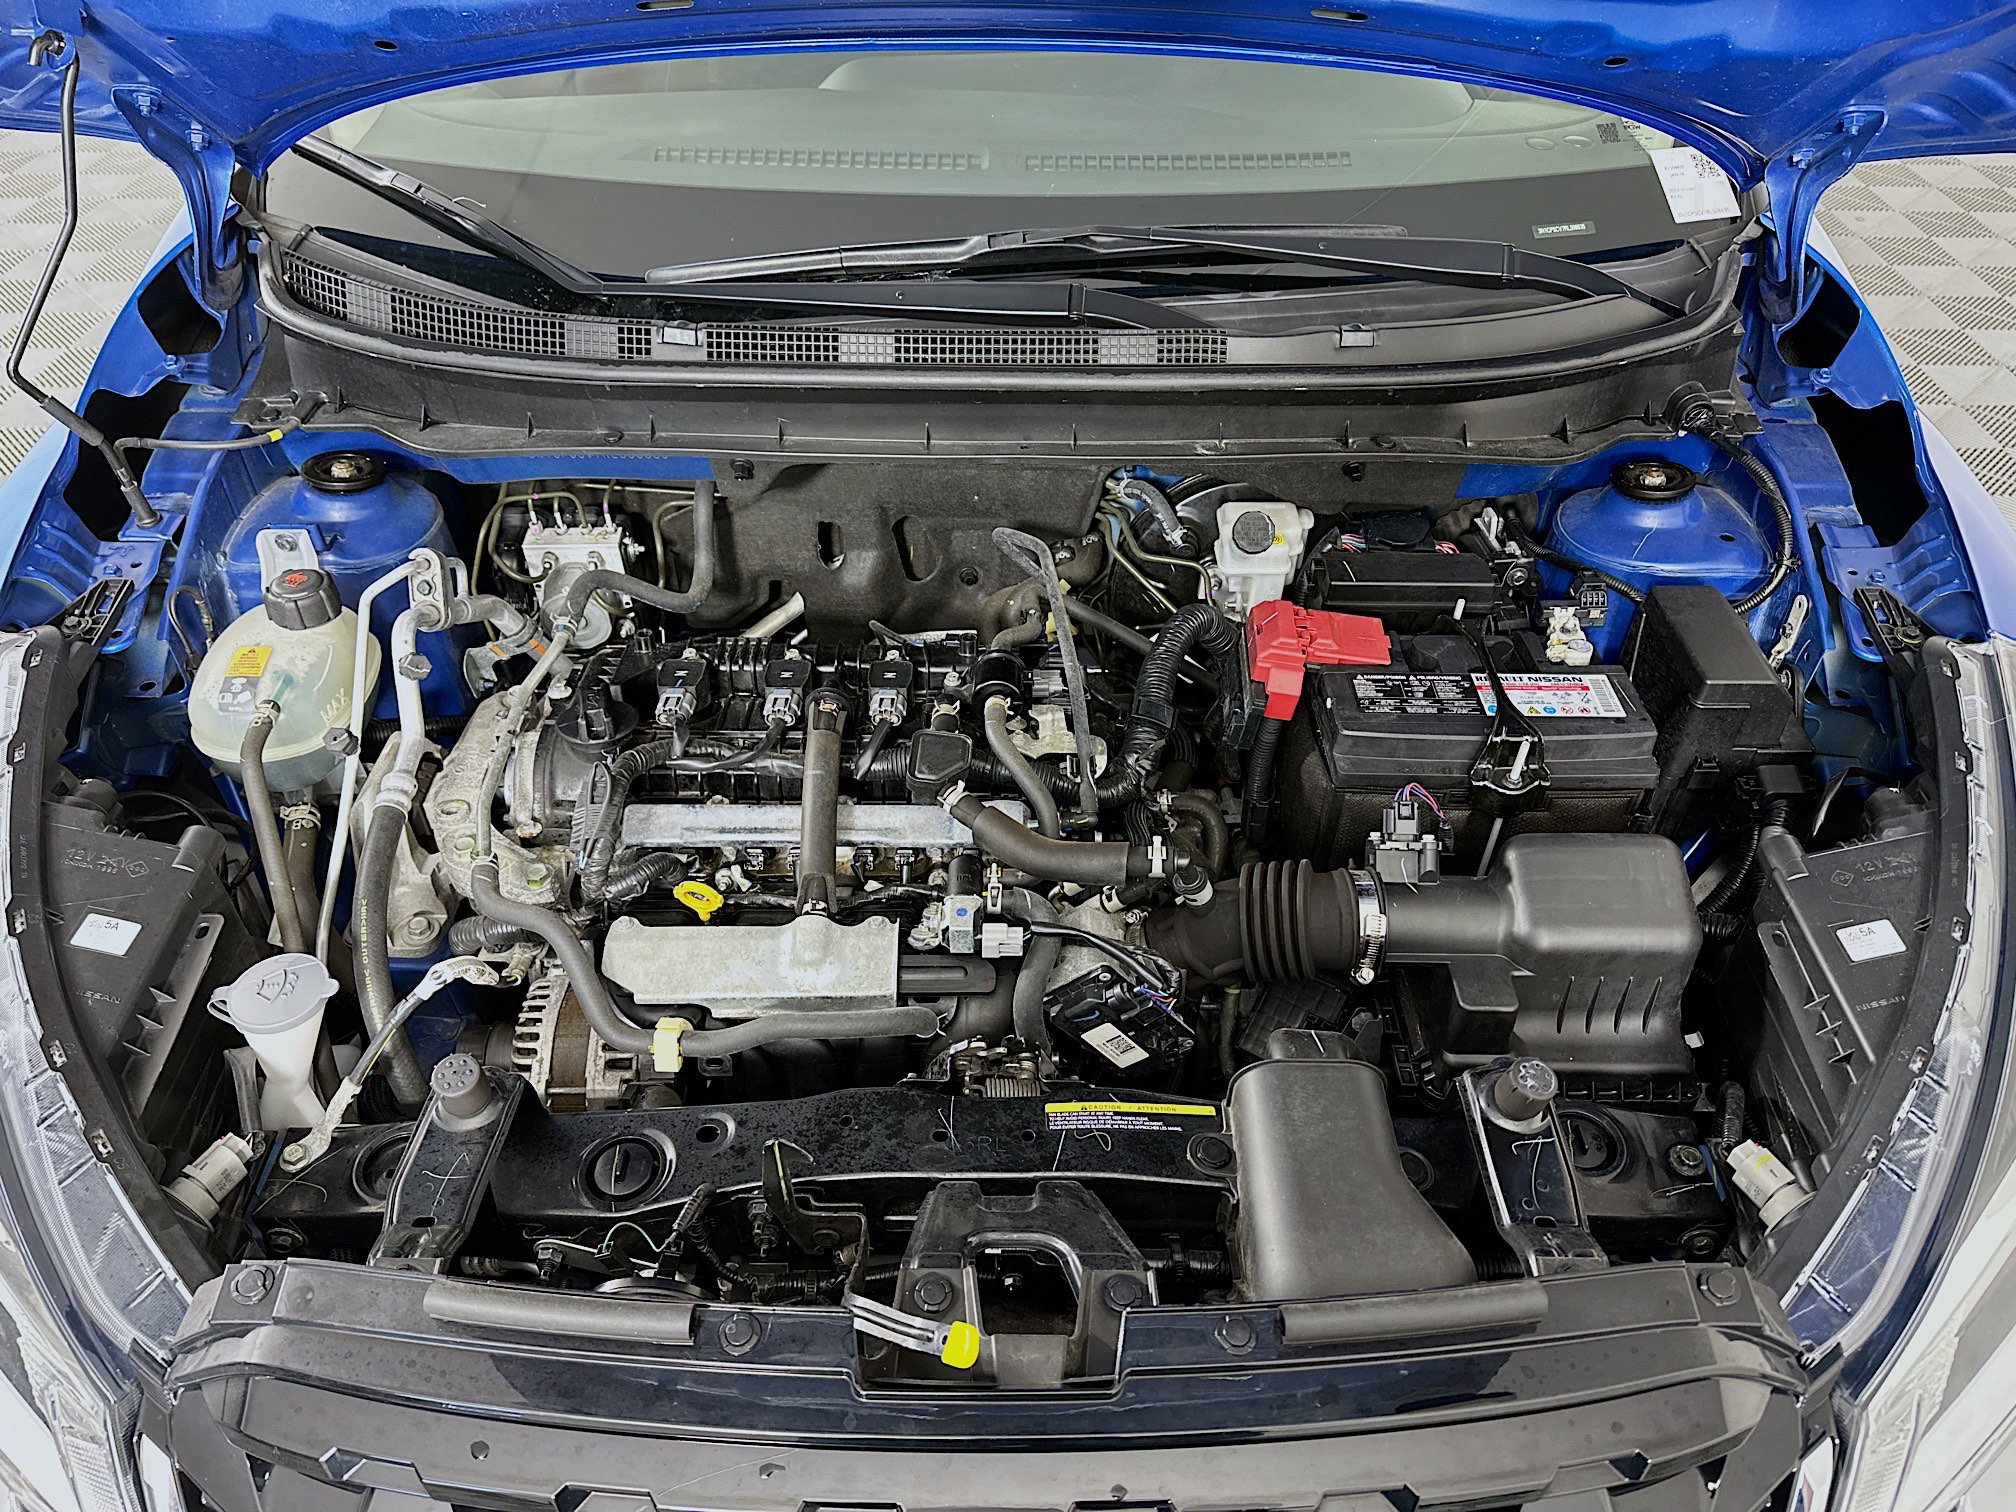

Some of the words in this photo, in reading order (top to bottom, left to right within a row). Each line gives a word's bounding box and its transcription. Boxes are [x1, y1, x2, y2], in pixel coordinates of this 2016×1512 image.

[320, 688, 350, 726] MAX
[104, 919, 120, 931] 5A
[1859, 926, 1876, 937] 5A
